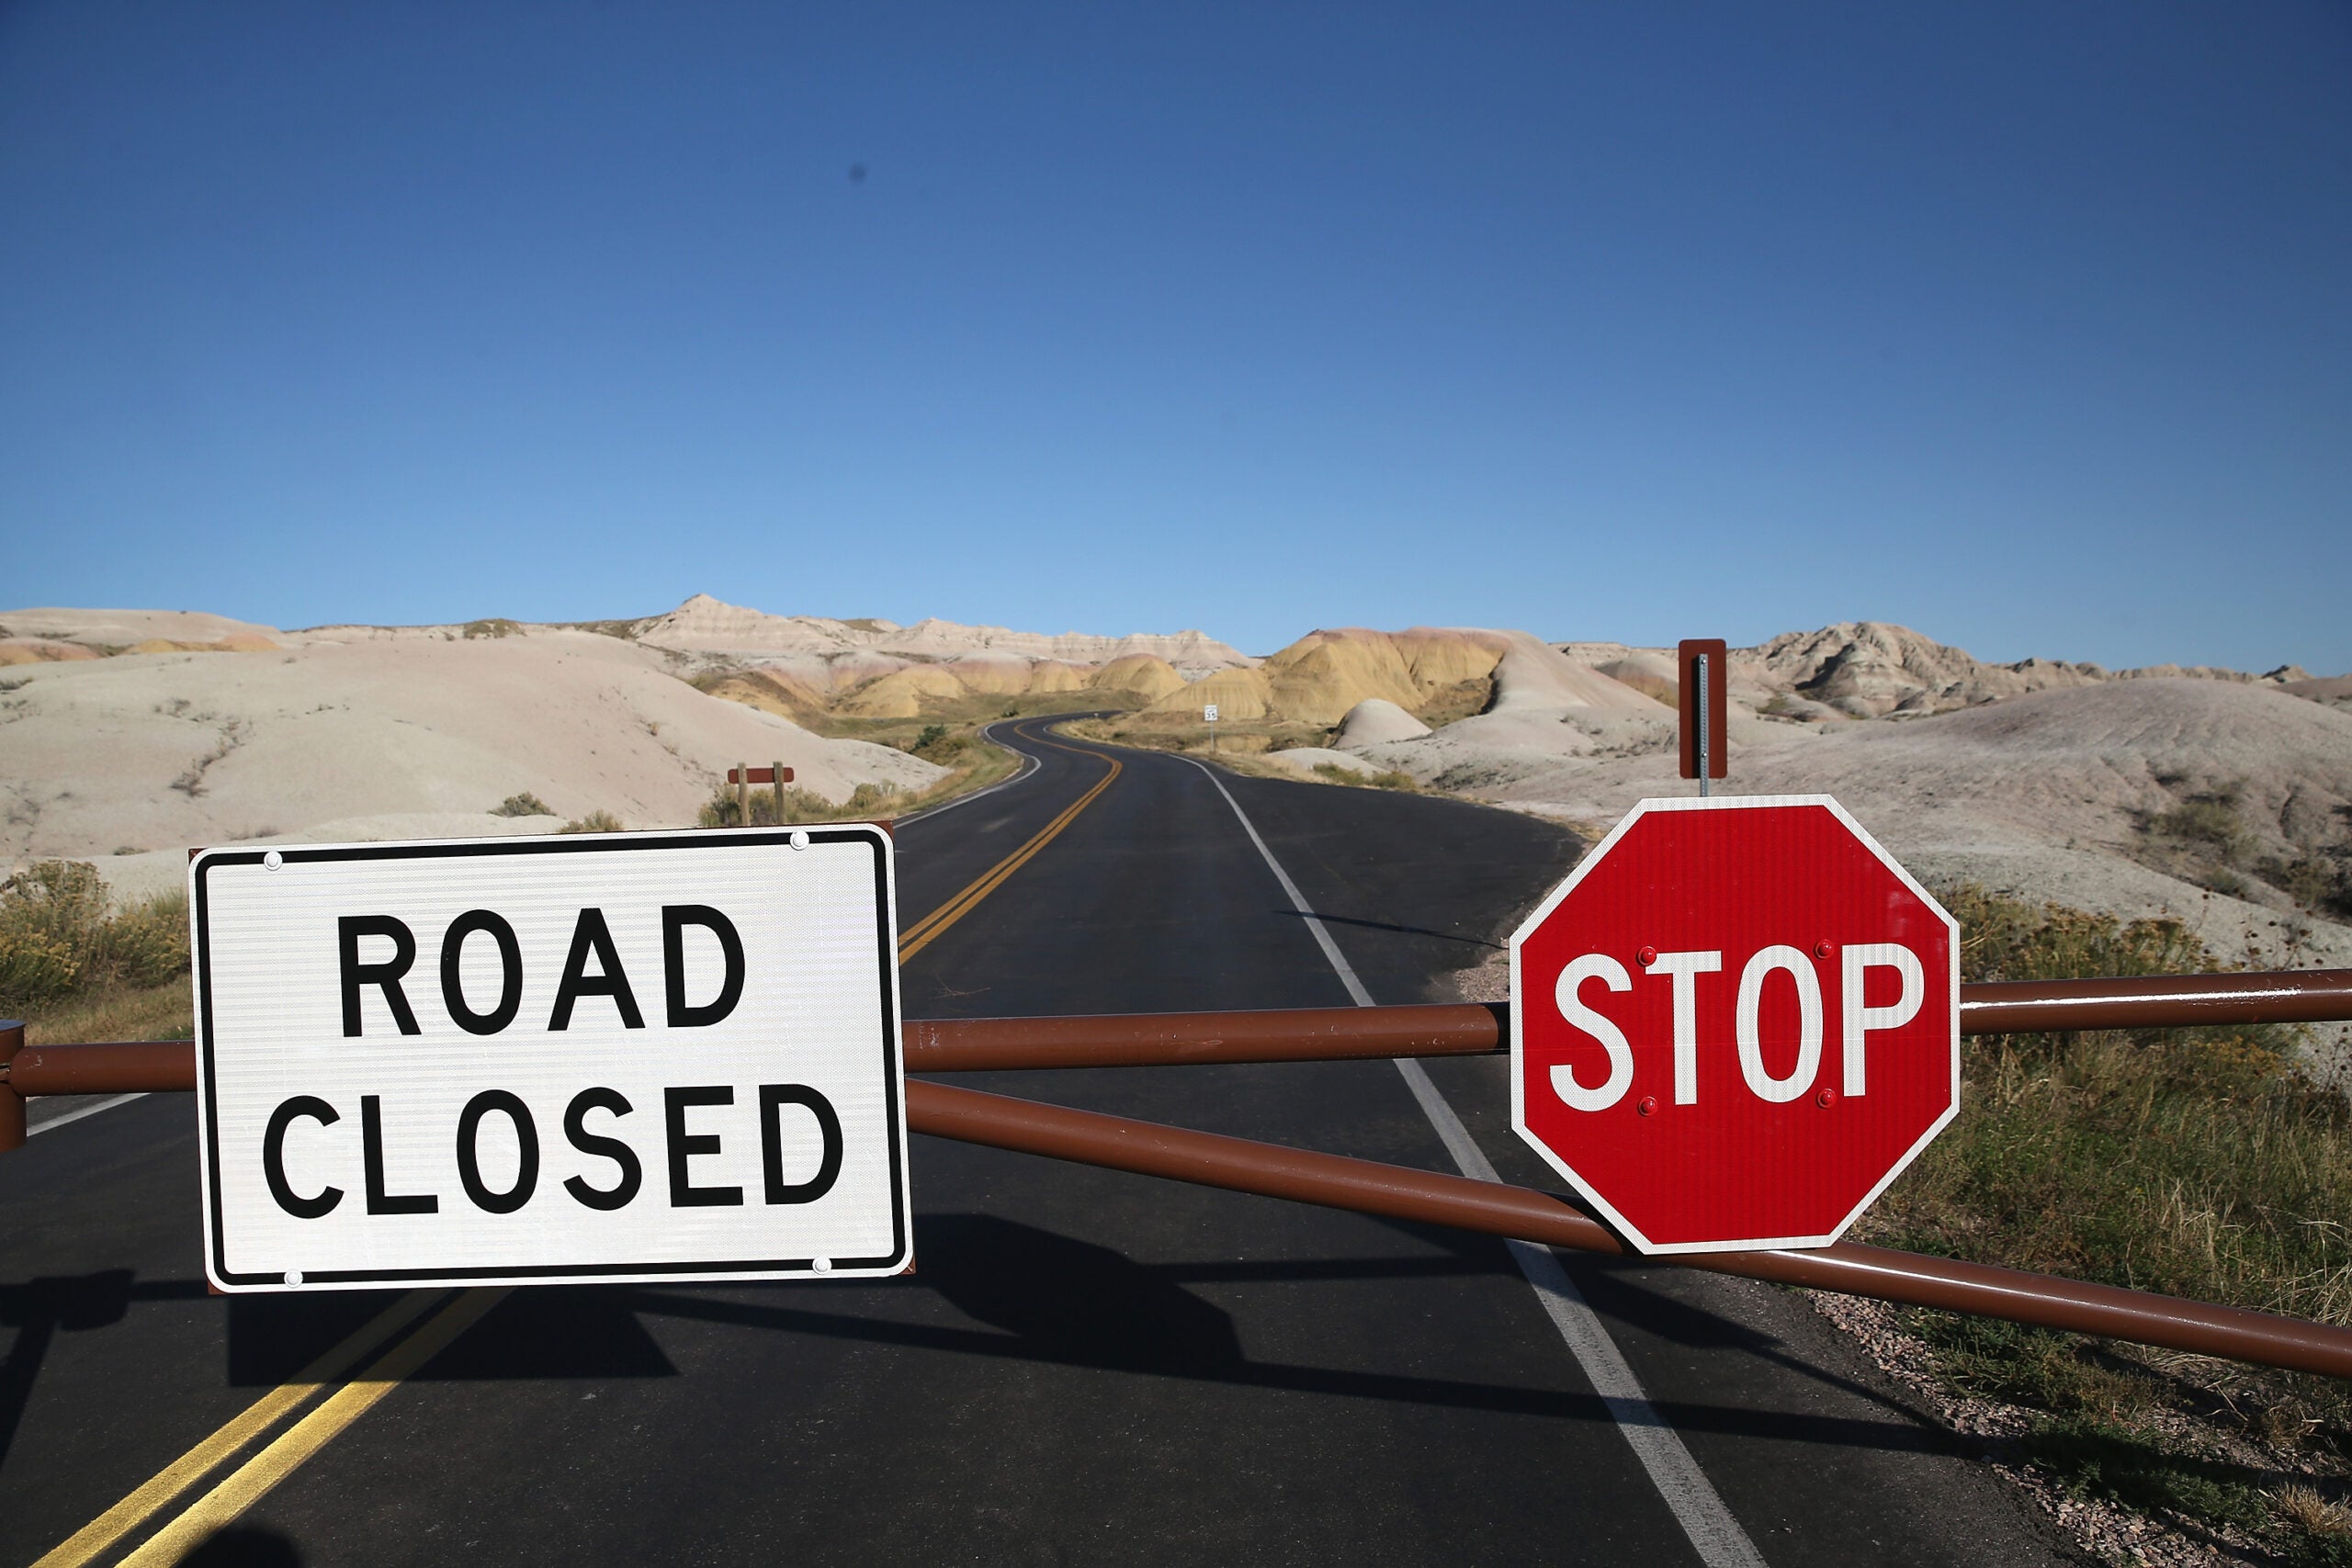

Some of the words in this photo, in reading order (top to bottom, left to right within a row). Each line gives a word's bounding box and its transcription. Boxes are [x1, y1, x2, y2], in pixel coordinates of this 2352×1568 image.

[338, 905, 745, 1037] ROAD
[1550, 943, 1924, 1111] STOP
[264, 1084, 842, 1219] CLOSED
